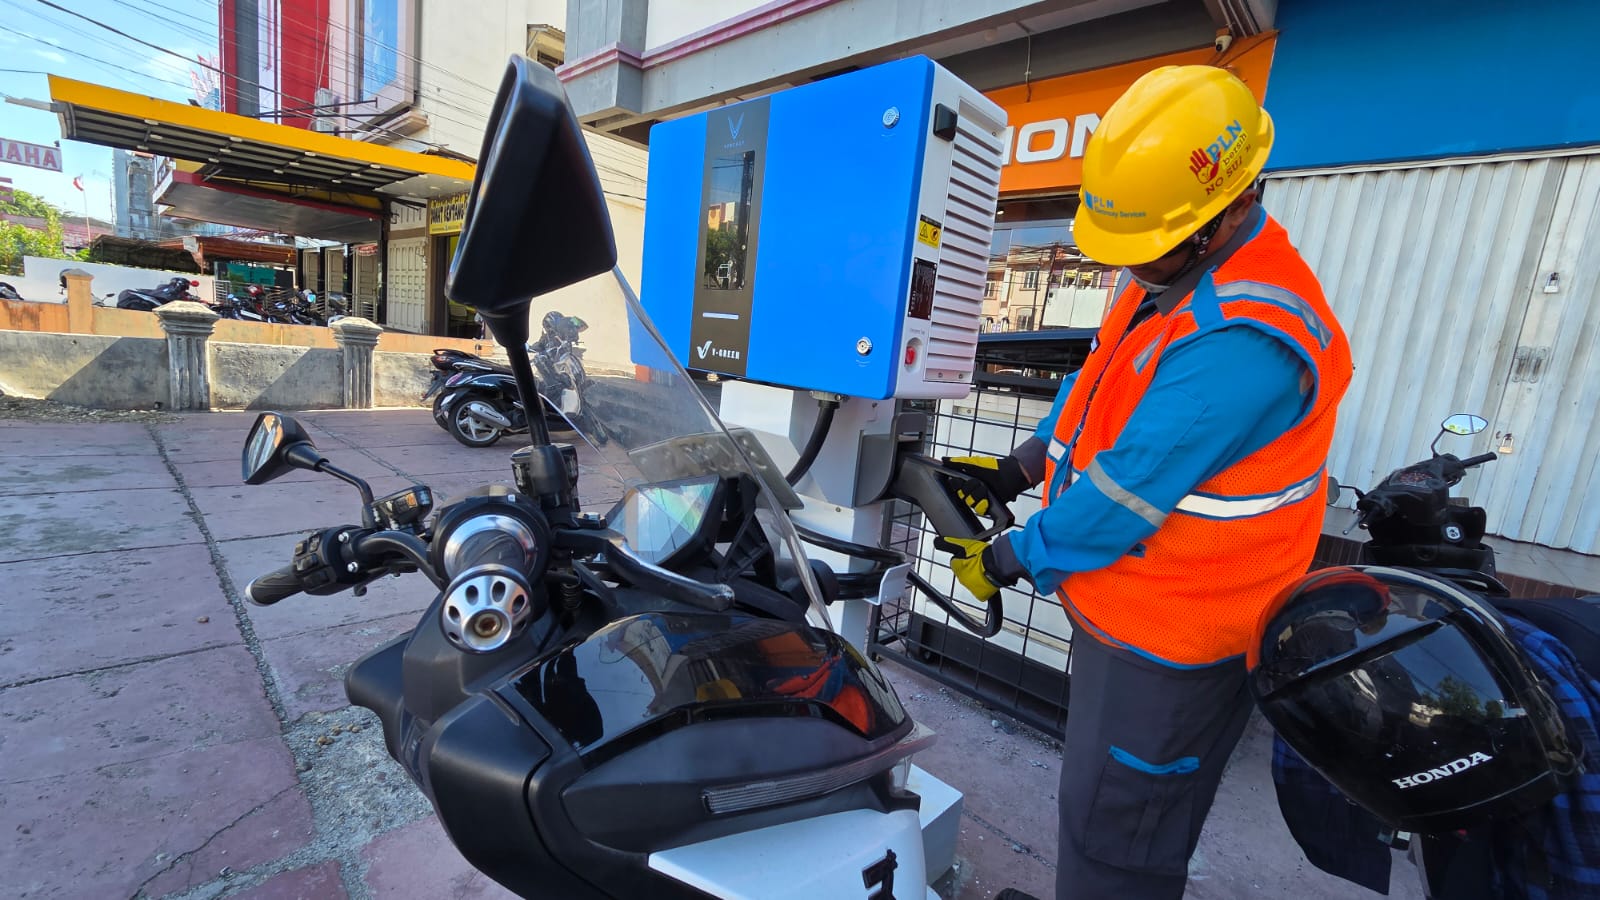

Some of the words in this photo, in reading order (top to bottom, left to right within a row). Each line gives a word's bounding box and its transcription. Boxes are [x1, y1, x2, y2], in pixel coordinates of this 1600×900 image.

[1205, 119, 1242, 164] PLN
[1223, 132, 1247, 165] bersih
[1093, 195, 1114, 209] PLN
[1206, 176, 1224, 196] NO
[1392, 751, 1493, 789] HONDA
